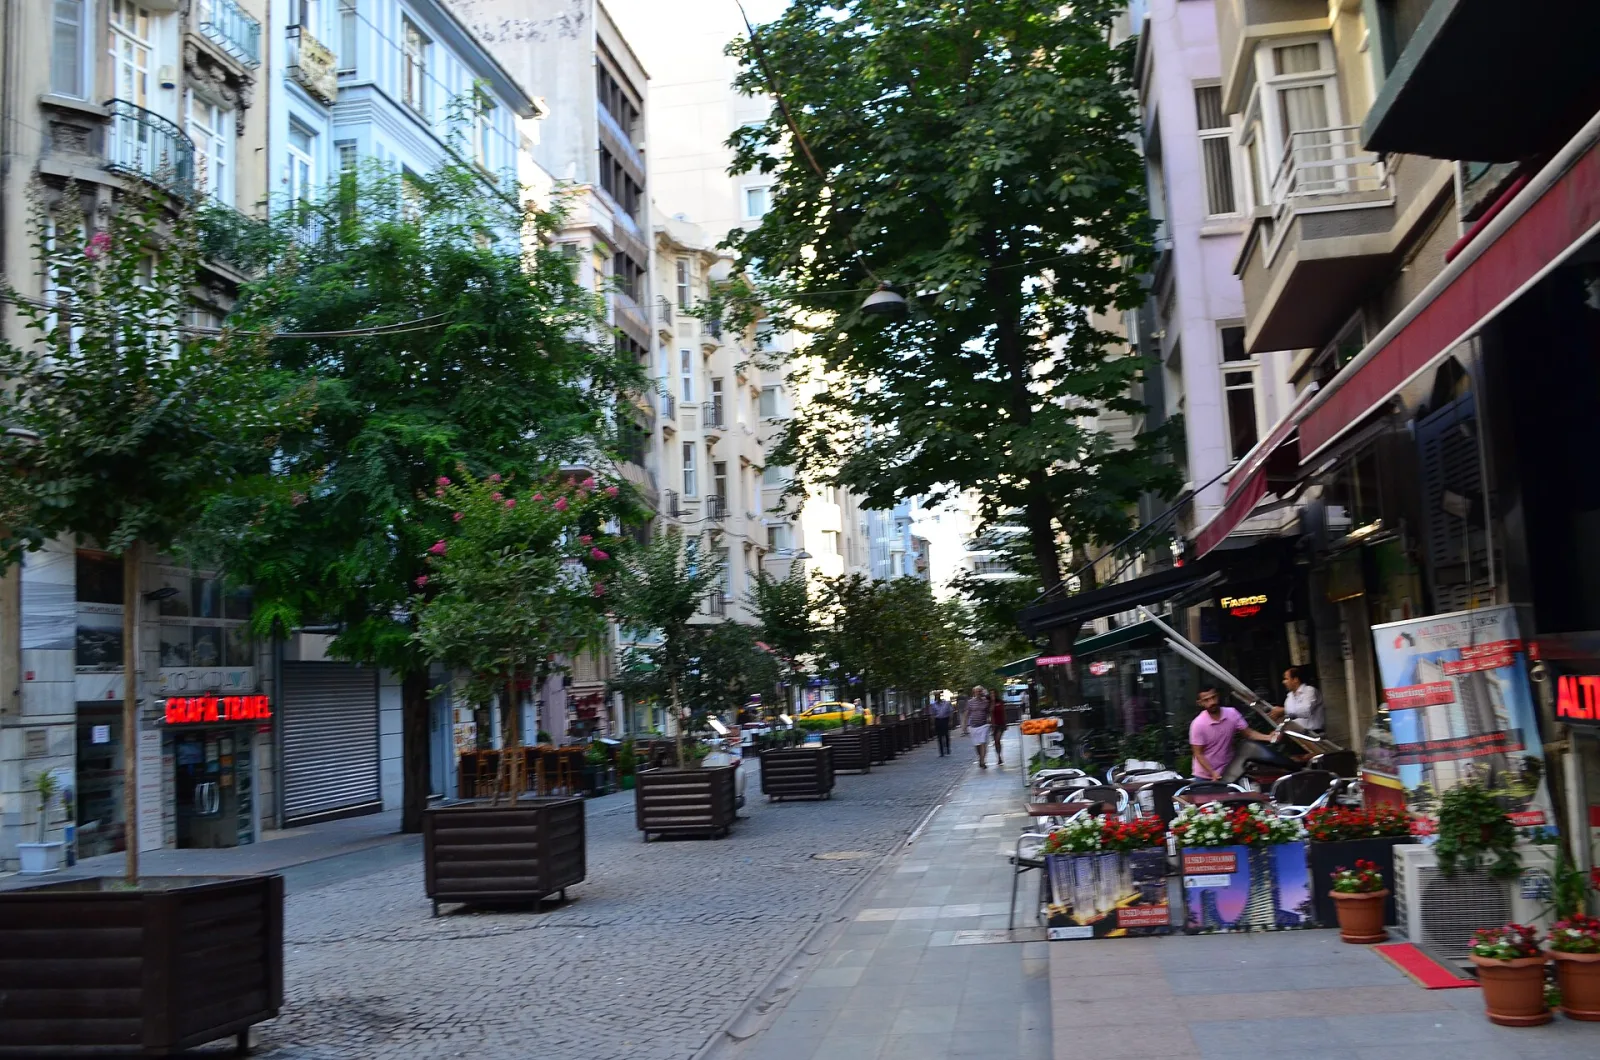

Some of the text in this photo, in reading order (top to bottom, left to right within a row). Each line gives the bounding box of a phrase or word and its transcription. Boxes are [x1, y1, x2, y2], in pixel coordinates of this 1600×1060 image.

[1386, 684, 1450, 699] Starting Price
[223, 695, 272, 720] TRAVEL
[1185, 856, 1205, 864] USD
[1118, 909, 1140, 917] USD
